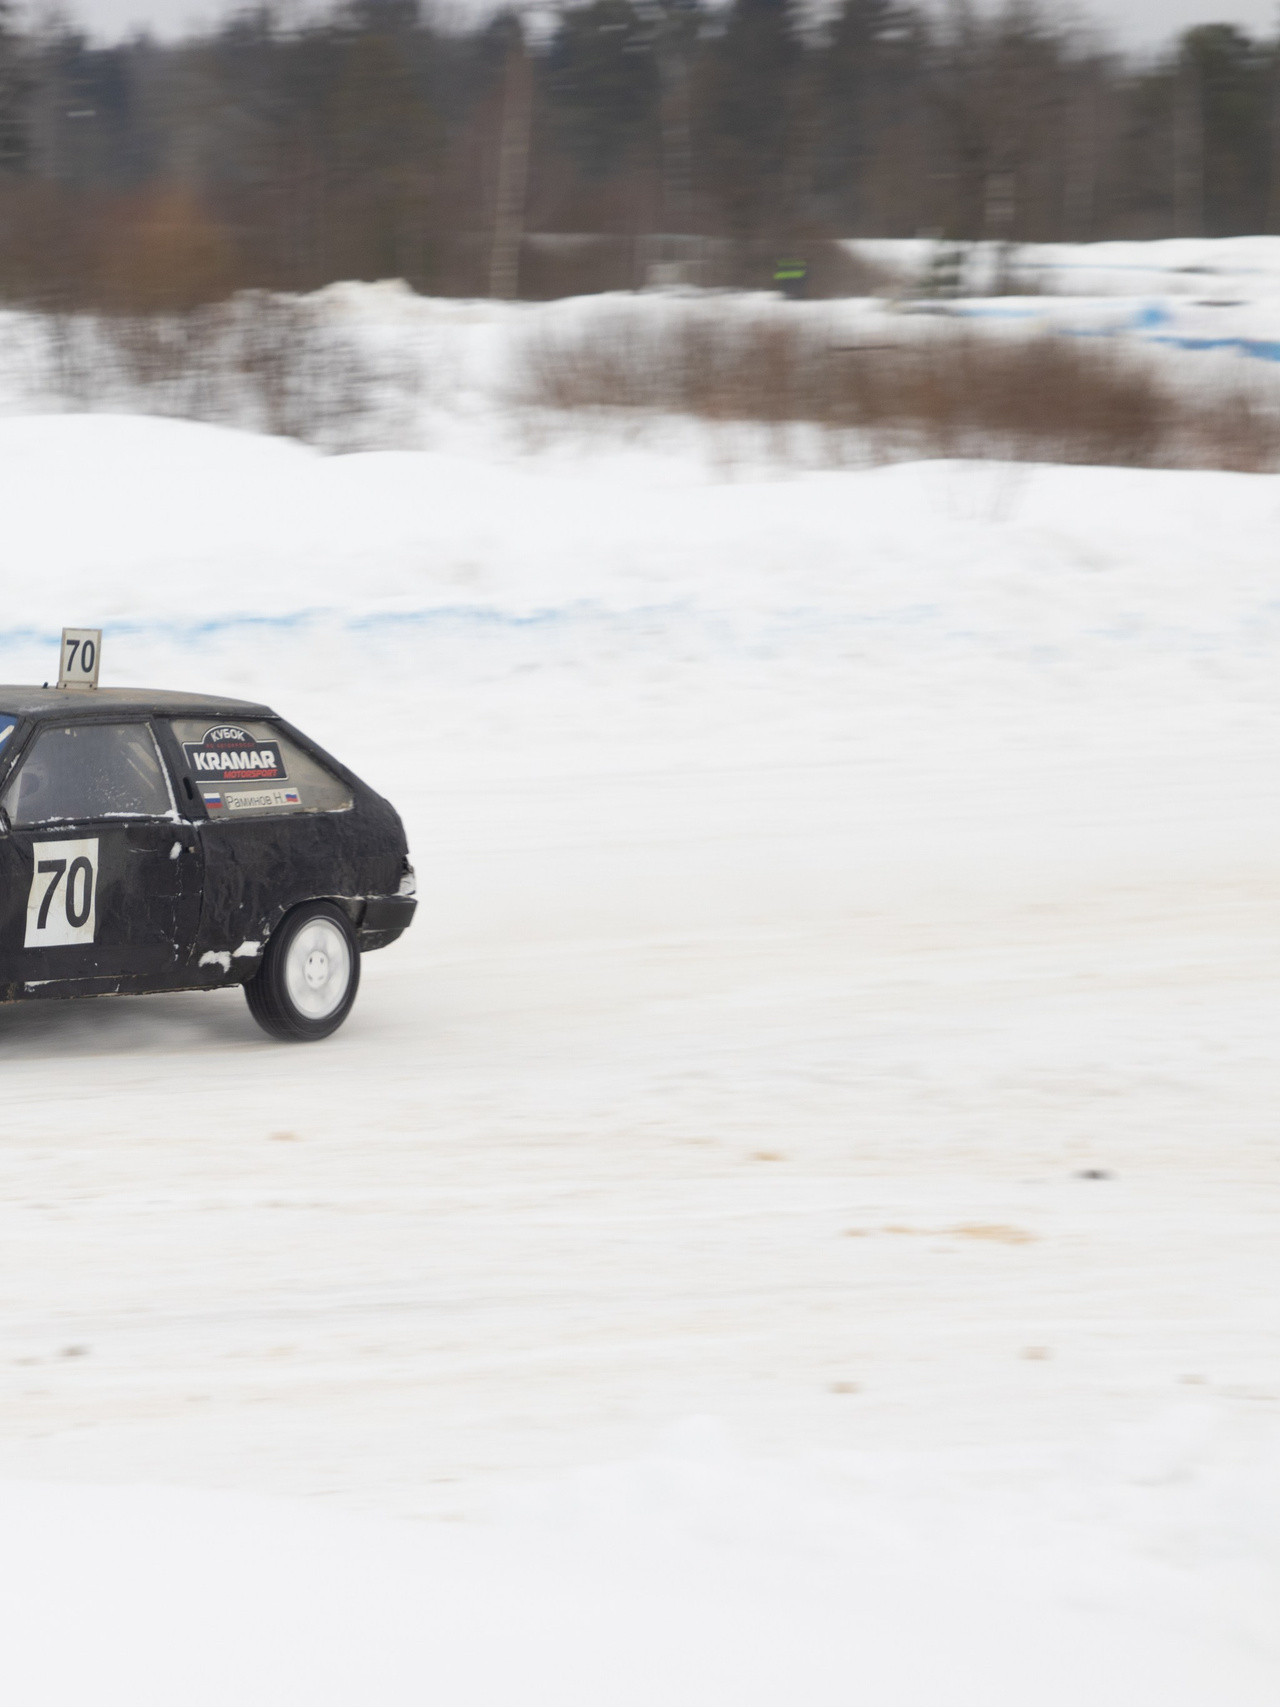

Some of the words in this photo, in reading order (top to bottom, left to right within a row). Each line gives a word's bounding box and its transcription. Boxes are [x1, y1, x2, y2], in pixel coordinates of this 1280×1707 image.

[66, 639, 95, 673] 70
[210, 728, 246, 742] КУБОК
[193, 750, 277, 771] KRAMAR
[223, 768, 278, 779] MOTORSPORT
[37, 856, 93, 929] 70
